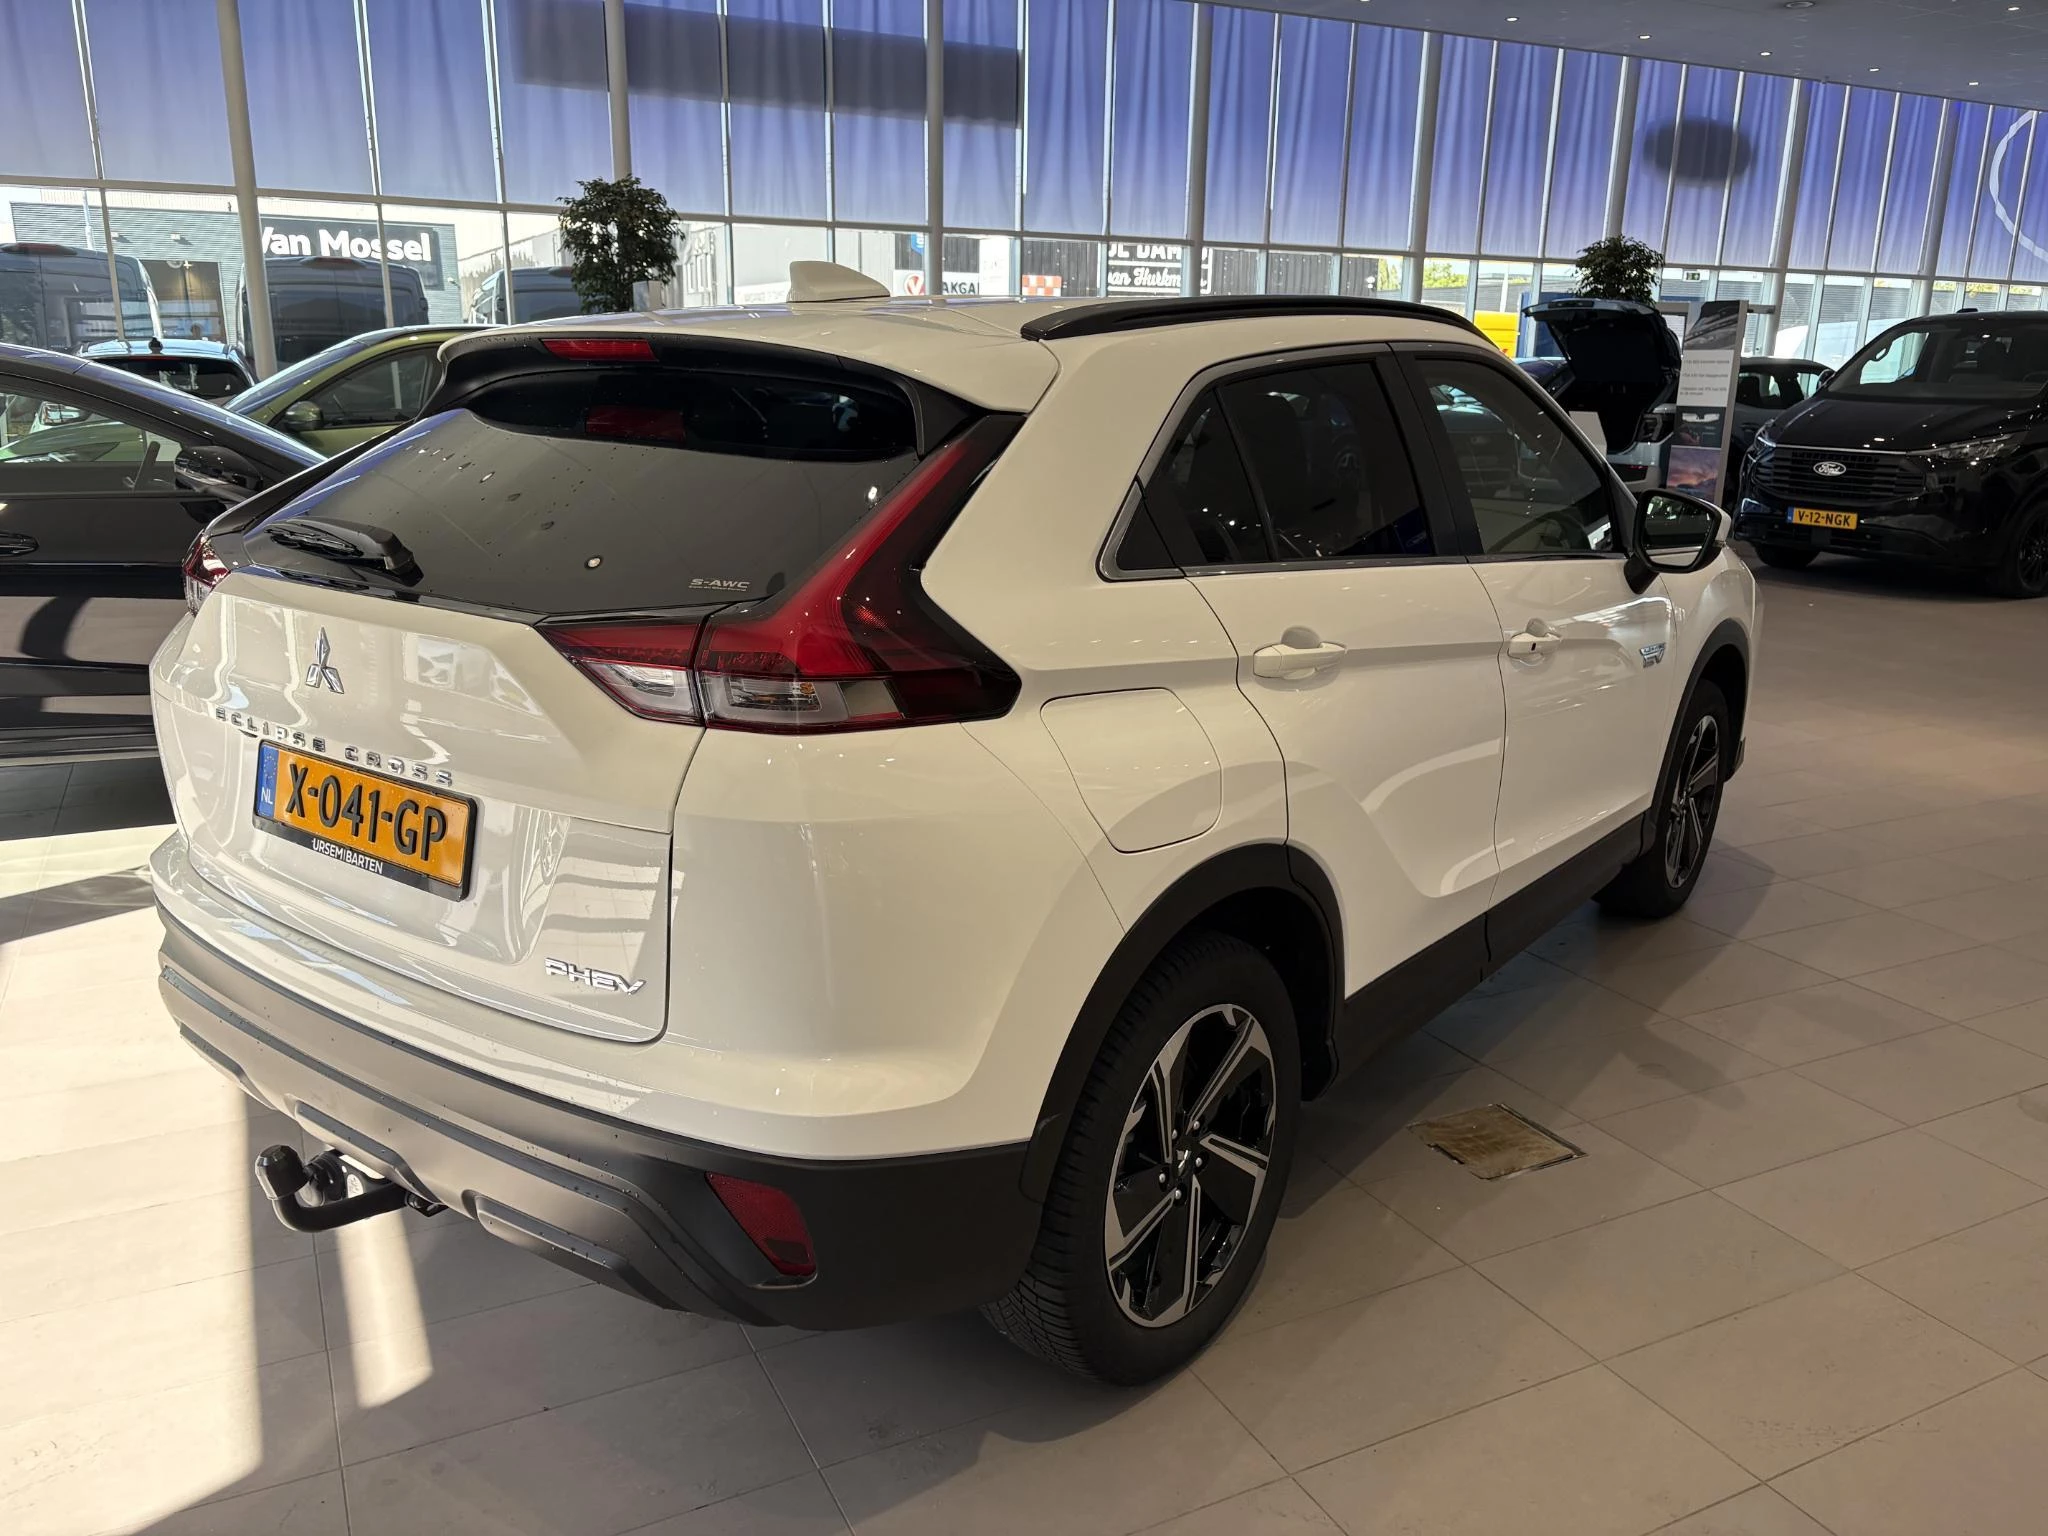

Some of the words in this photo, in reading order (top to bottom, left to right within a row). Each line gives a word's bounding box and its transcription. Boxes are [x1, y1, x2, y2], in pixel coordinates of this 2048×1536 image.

[319, 229, 431, 262] Mossel
[942, 282, 980, 294] AKGA
[1816, 462, 1843, 475] Ford
[1797, 510, 1851, 527] V-12-NGK
[690, 578, 750, 588] S-AWC
[216, 707, 326, 753] ECLIPSE
[344, 745, 453, 787] CROSS
[261, 787, 273, 805] NL
[285, 763, 448, 862] X-041-GP
[544, 957, 647, 995] PHEV
